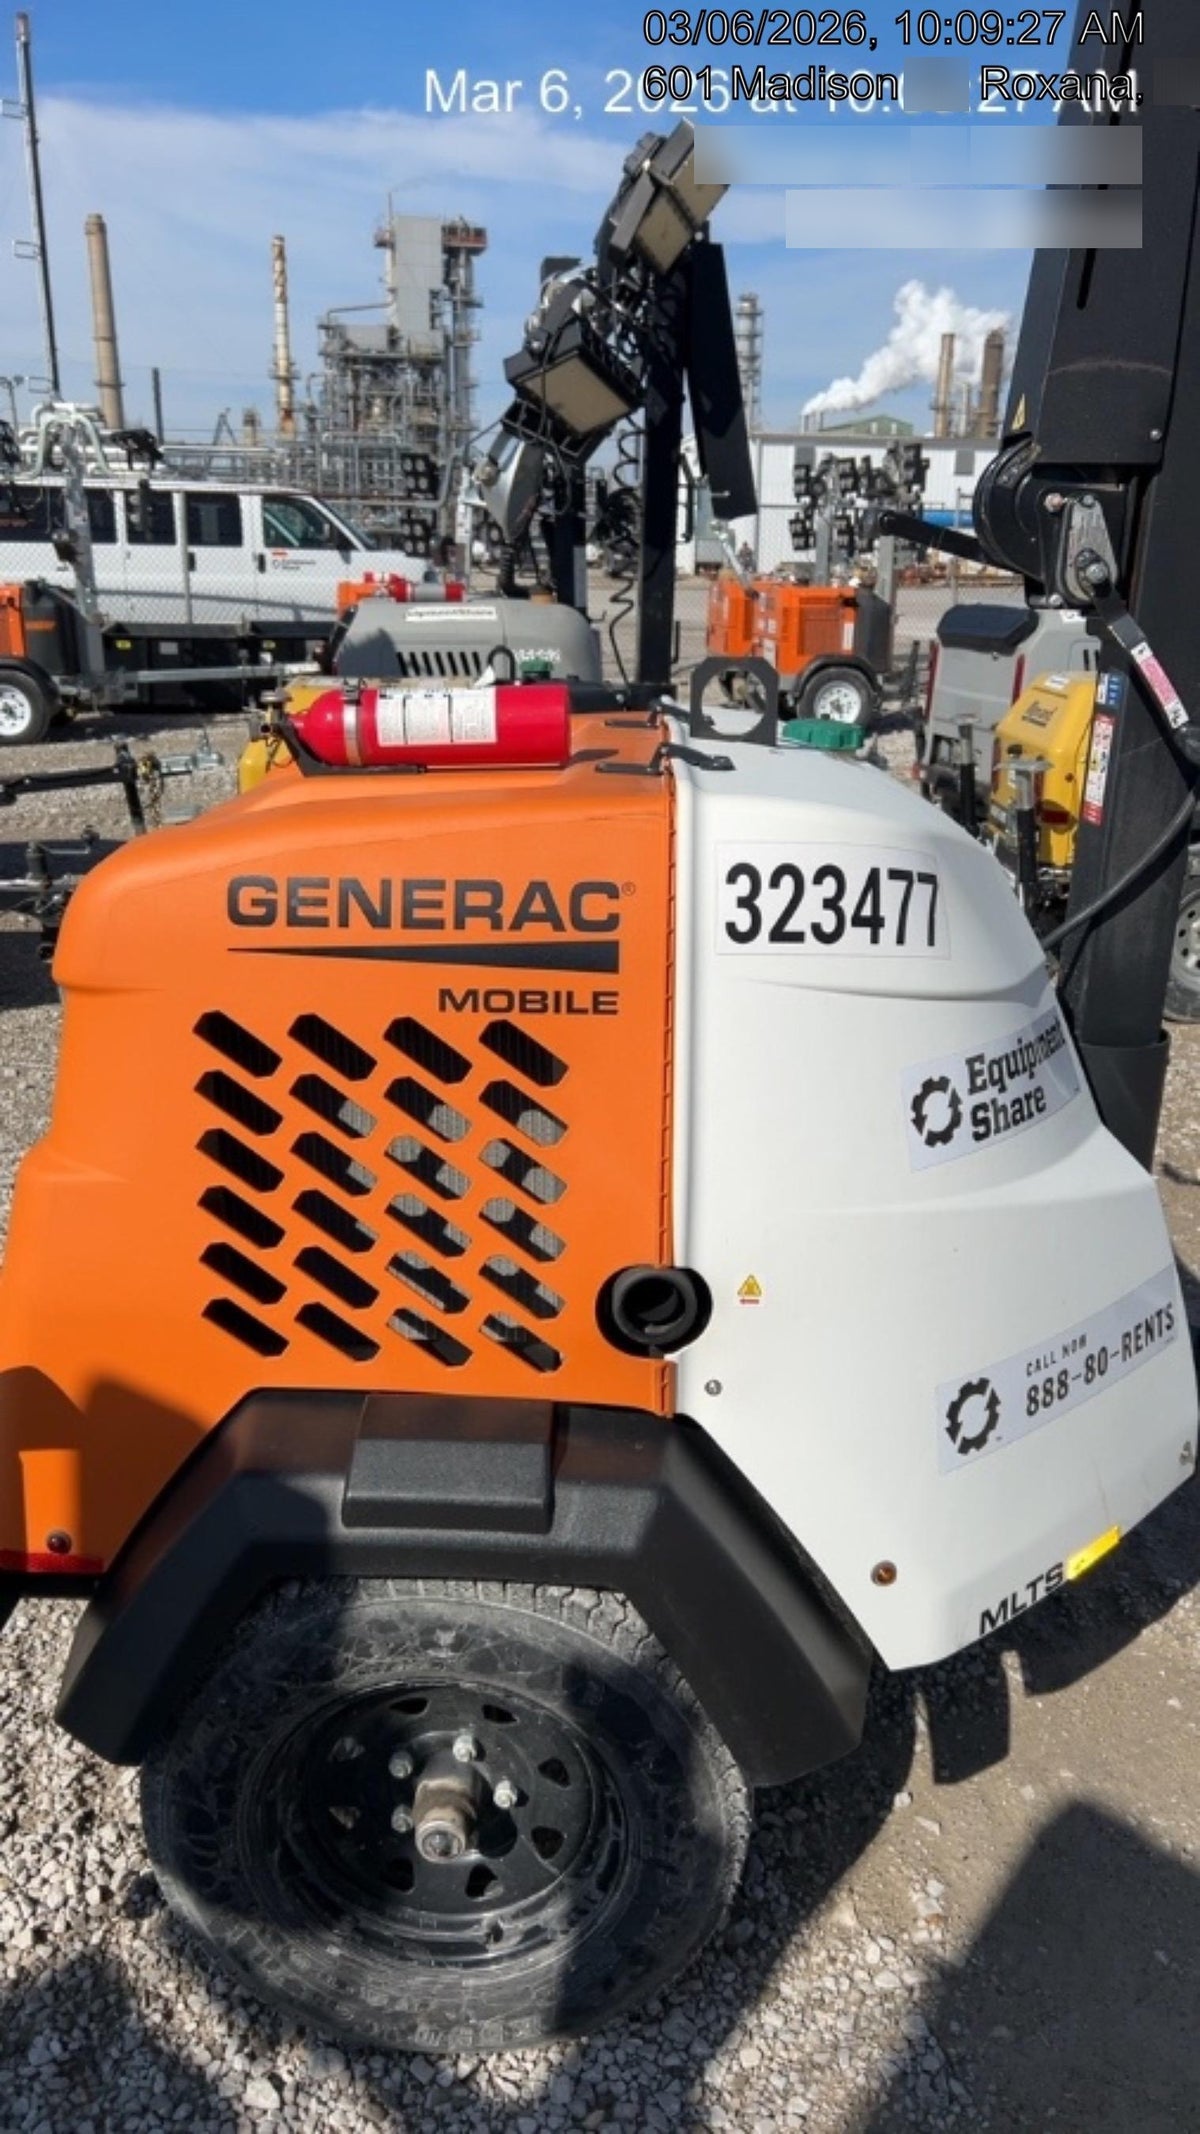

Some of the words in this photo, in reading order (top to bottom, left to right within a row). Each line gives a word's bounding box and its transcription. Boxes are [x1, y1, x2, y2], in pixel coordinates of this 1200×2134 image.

[725, 862, 938, 946] 323477
[438, 988, 619, 1015] MOBILE
[970, 1086, 1046, 1142] Share
[1026, 1351, 1057, 1377] CALL
[1062, 1333, 1087, 1359] NOW
[1026, 1302, 1175, 1417] 888-80-RENTS
